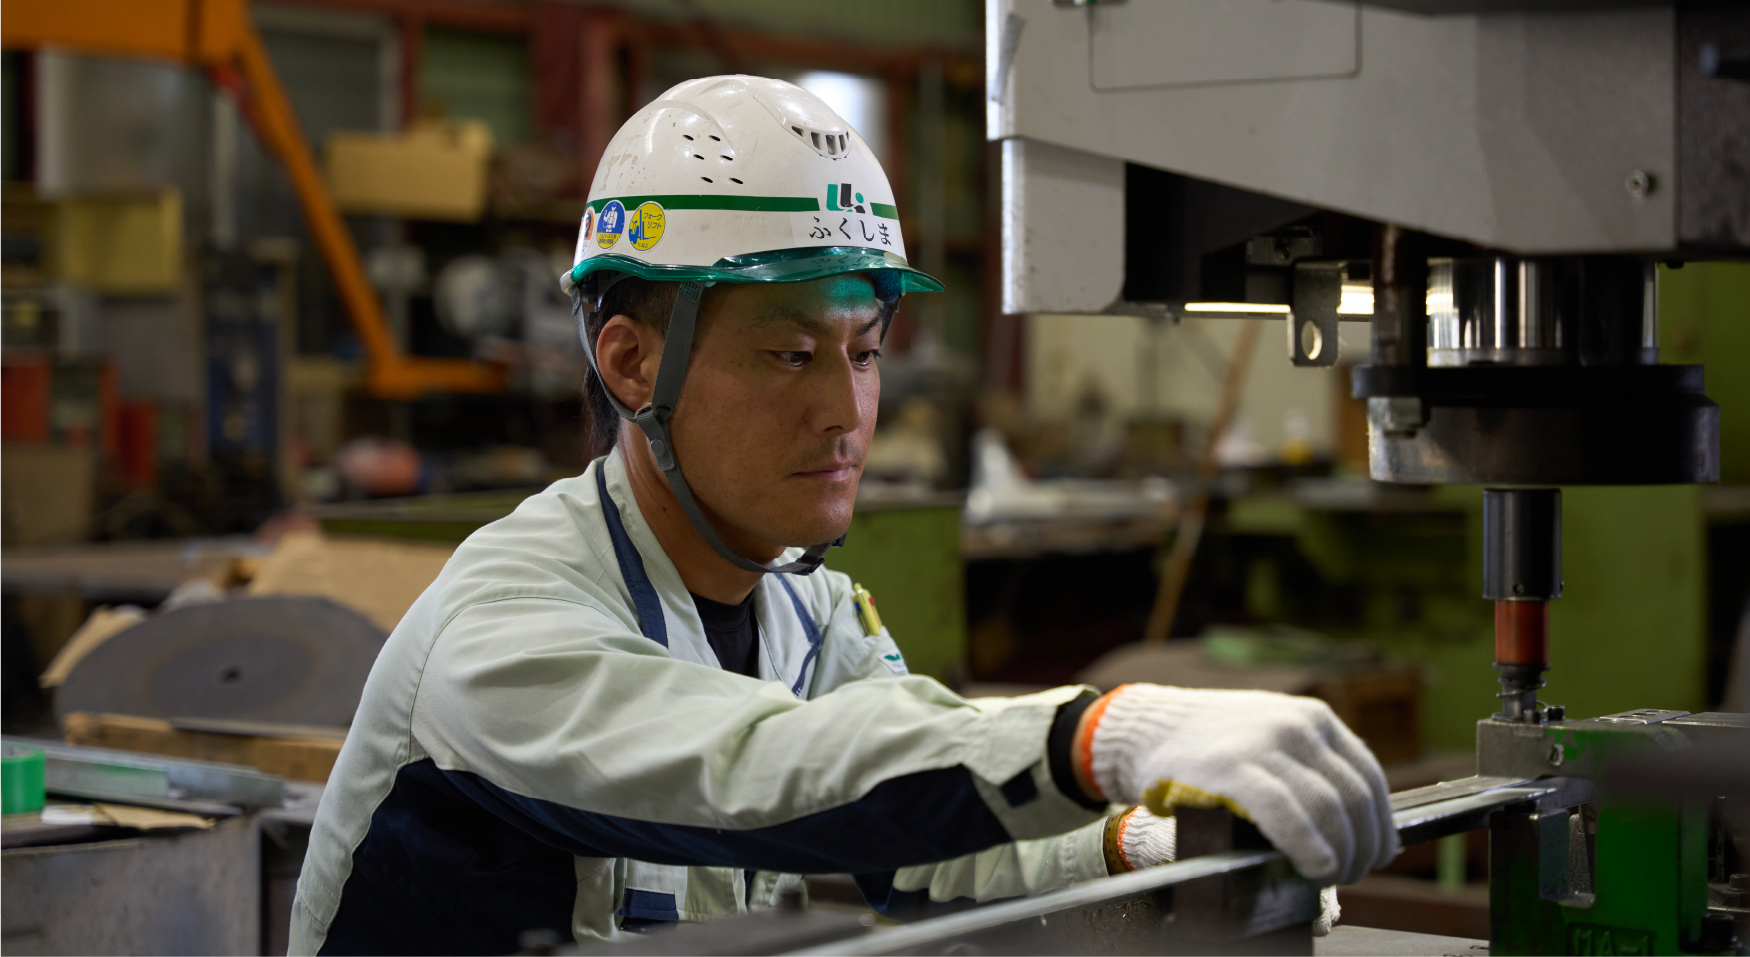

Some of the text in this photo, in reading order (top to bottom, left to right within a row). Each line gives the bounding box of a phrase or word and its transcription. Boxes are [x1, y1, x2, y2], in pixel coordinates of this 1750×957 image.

[643, 212, 662, 221] フォーク
[647, 221, 662, 229] リフト
[809, 216, 891, 246] ふくしま
